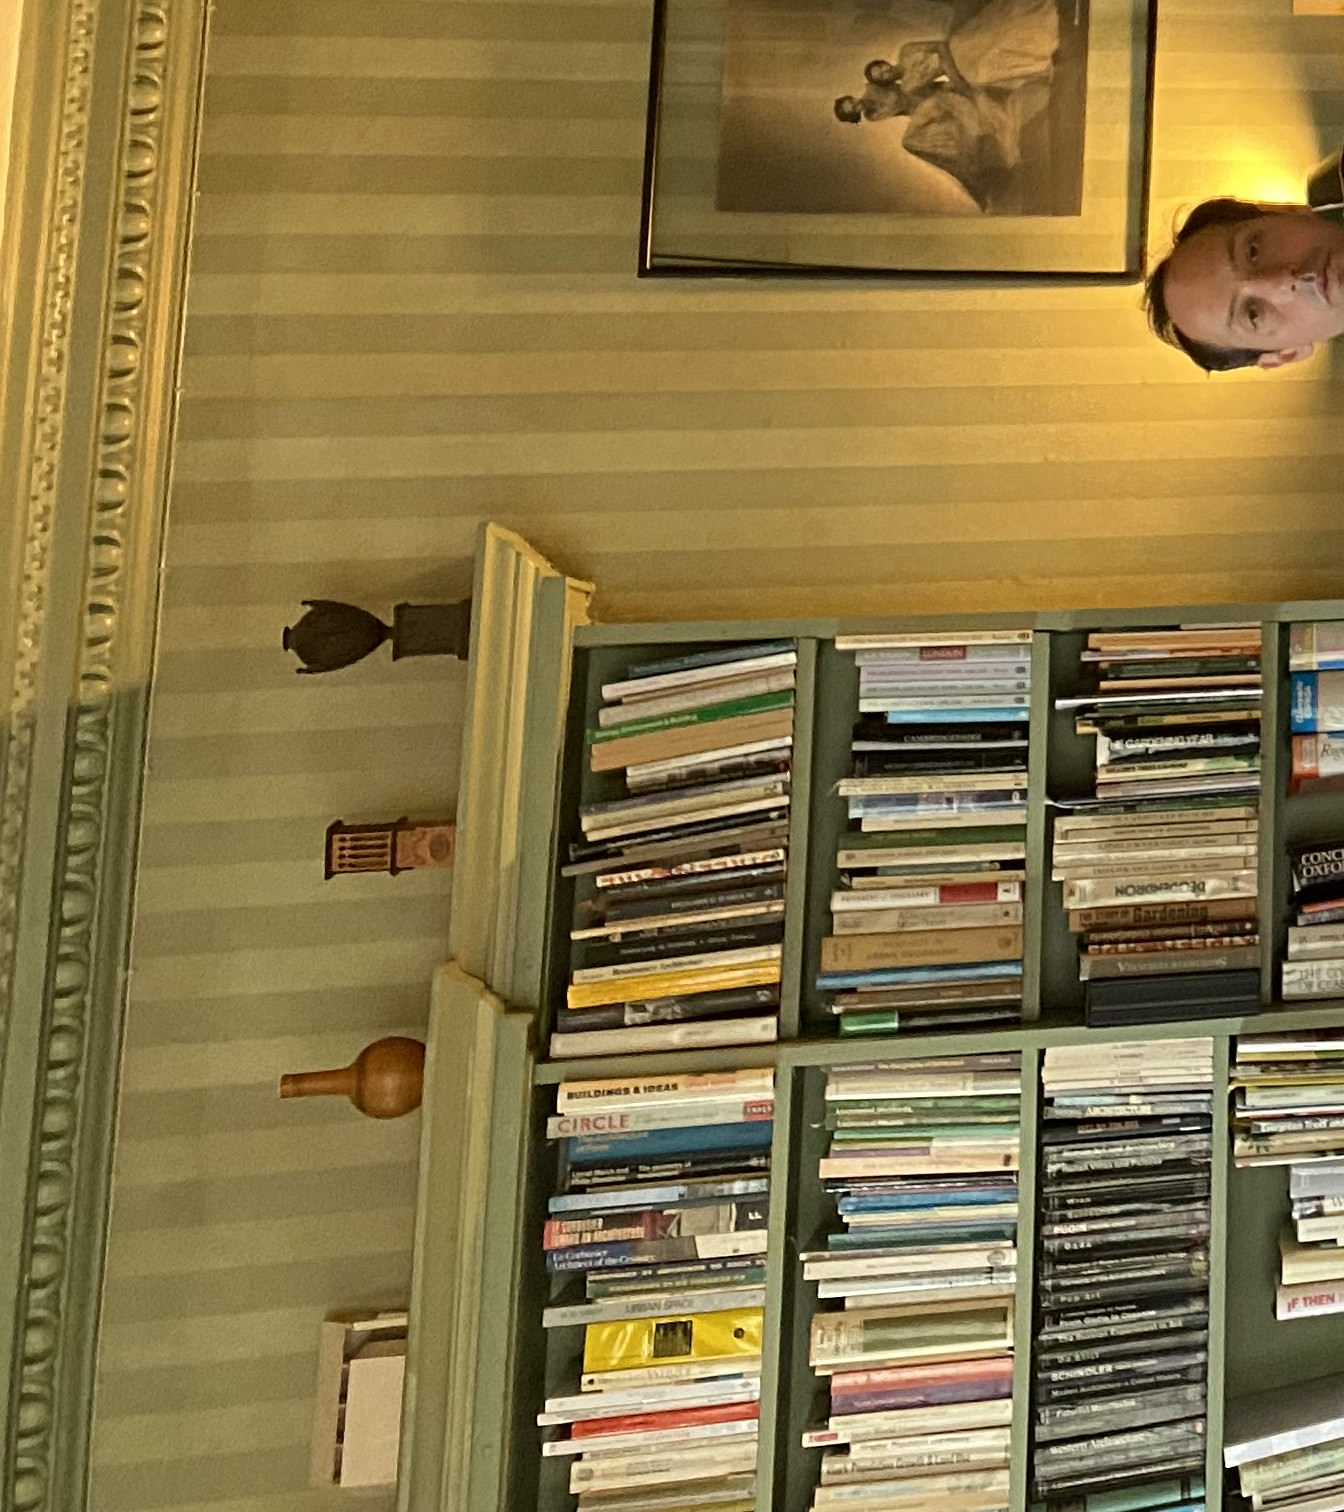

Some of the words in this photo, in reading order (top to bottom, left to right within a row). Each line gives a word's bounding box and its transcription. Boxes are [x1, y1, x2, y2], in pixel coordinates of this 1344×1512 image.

[1132, 902, 1208, 924] Gardening
[566, 1085, 632, 1100] BUILDINGS
[642, 1082, 679, 1095] IDEAS
[557, 1113, 630, 1135] CIRCLE
[1303, 1293, 1336, 1309] THEN
